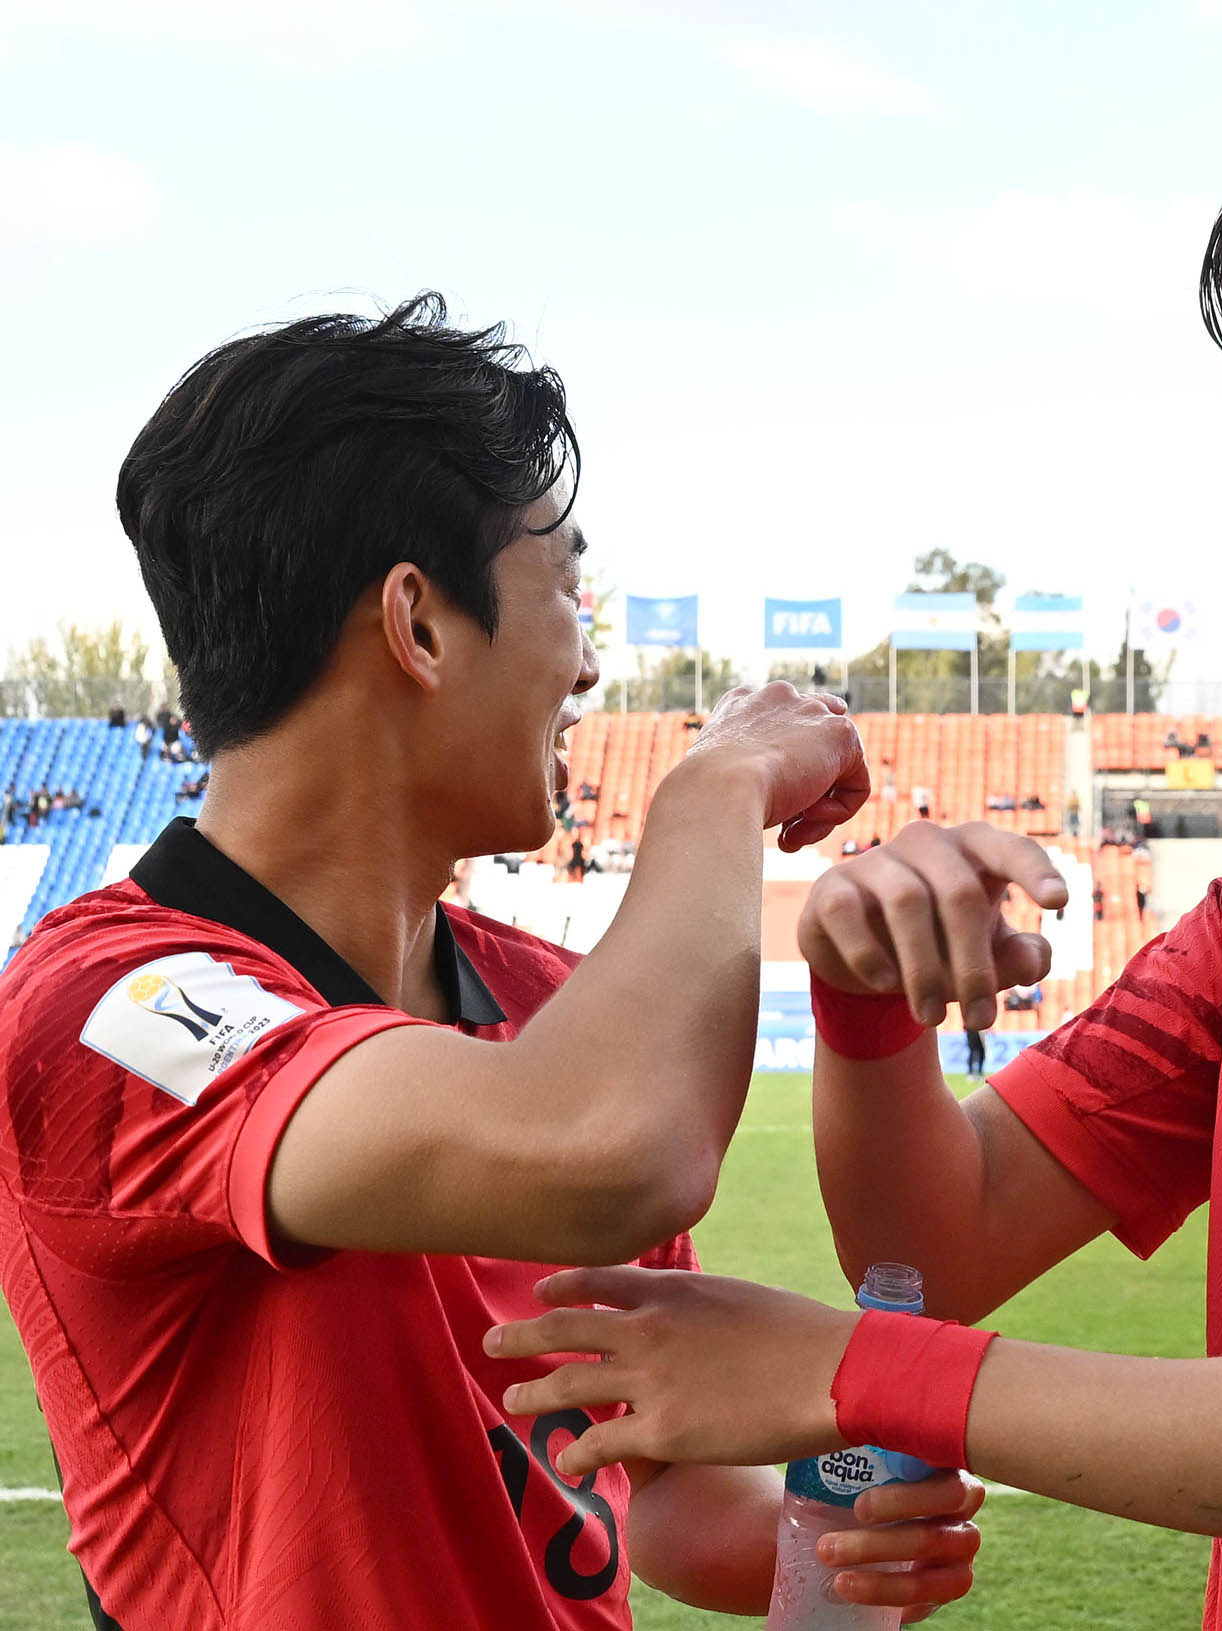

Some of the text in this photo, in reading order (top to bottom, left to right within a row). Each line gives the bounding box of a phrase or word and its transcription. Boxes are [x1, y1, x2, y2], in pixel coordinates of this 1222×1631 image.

[773, 611, 832, 635] FIFA
[209, 1024, 235, 1045] FIFA
[248, 1017, 271, 1034] 2023
[208, 1015, 257, 1072] U-20 WOD CUP
[486, 1408, 619, 1600] 18
